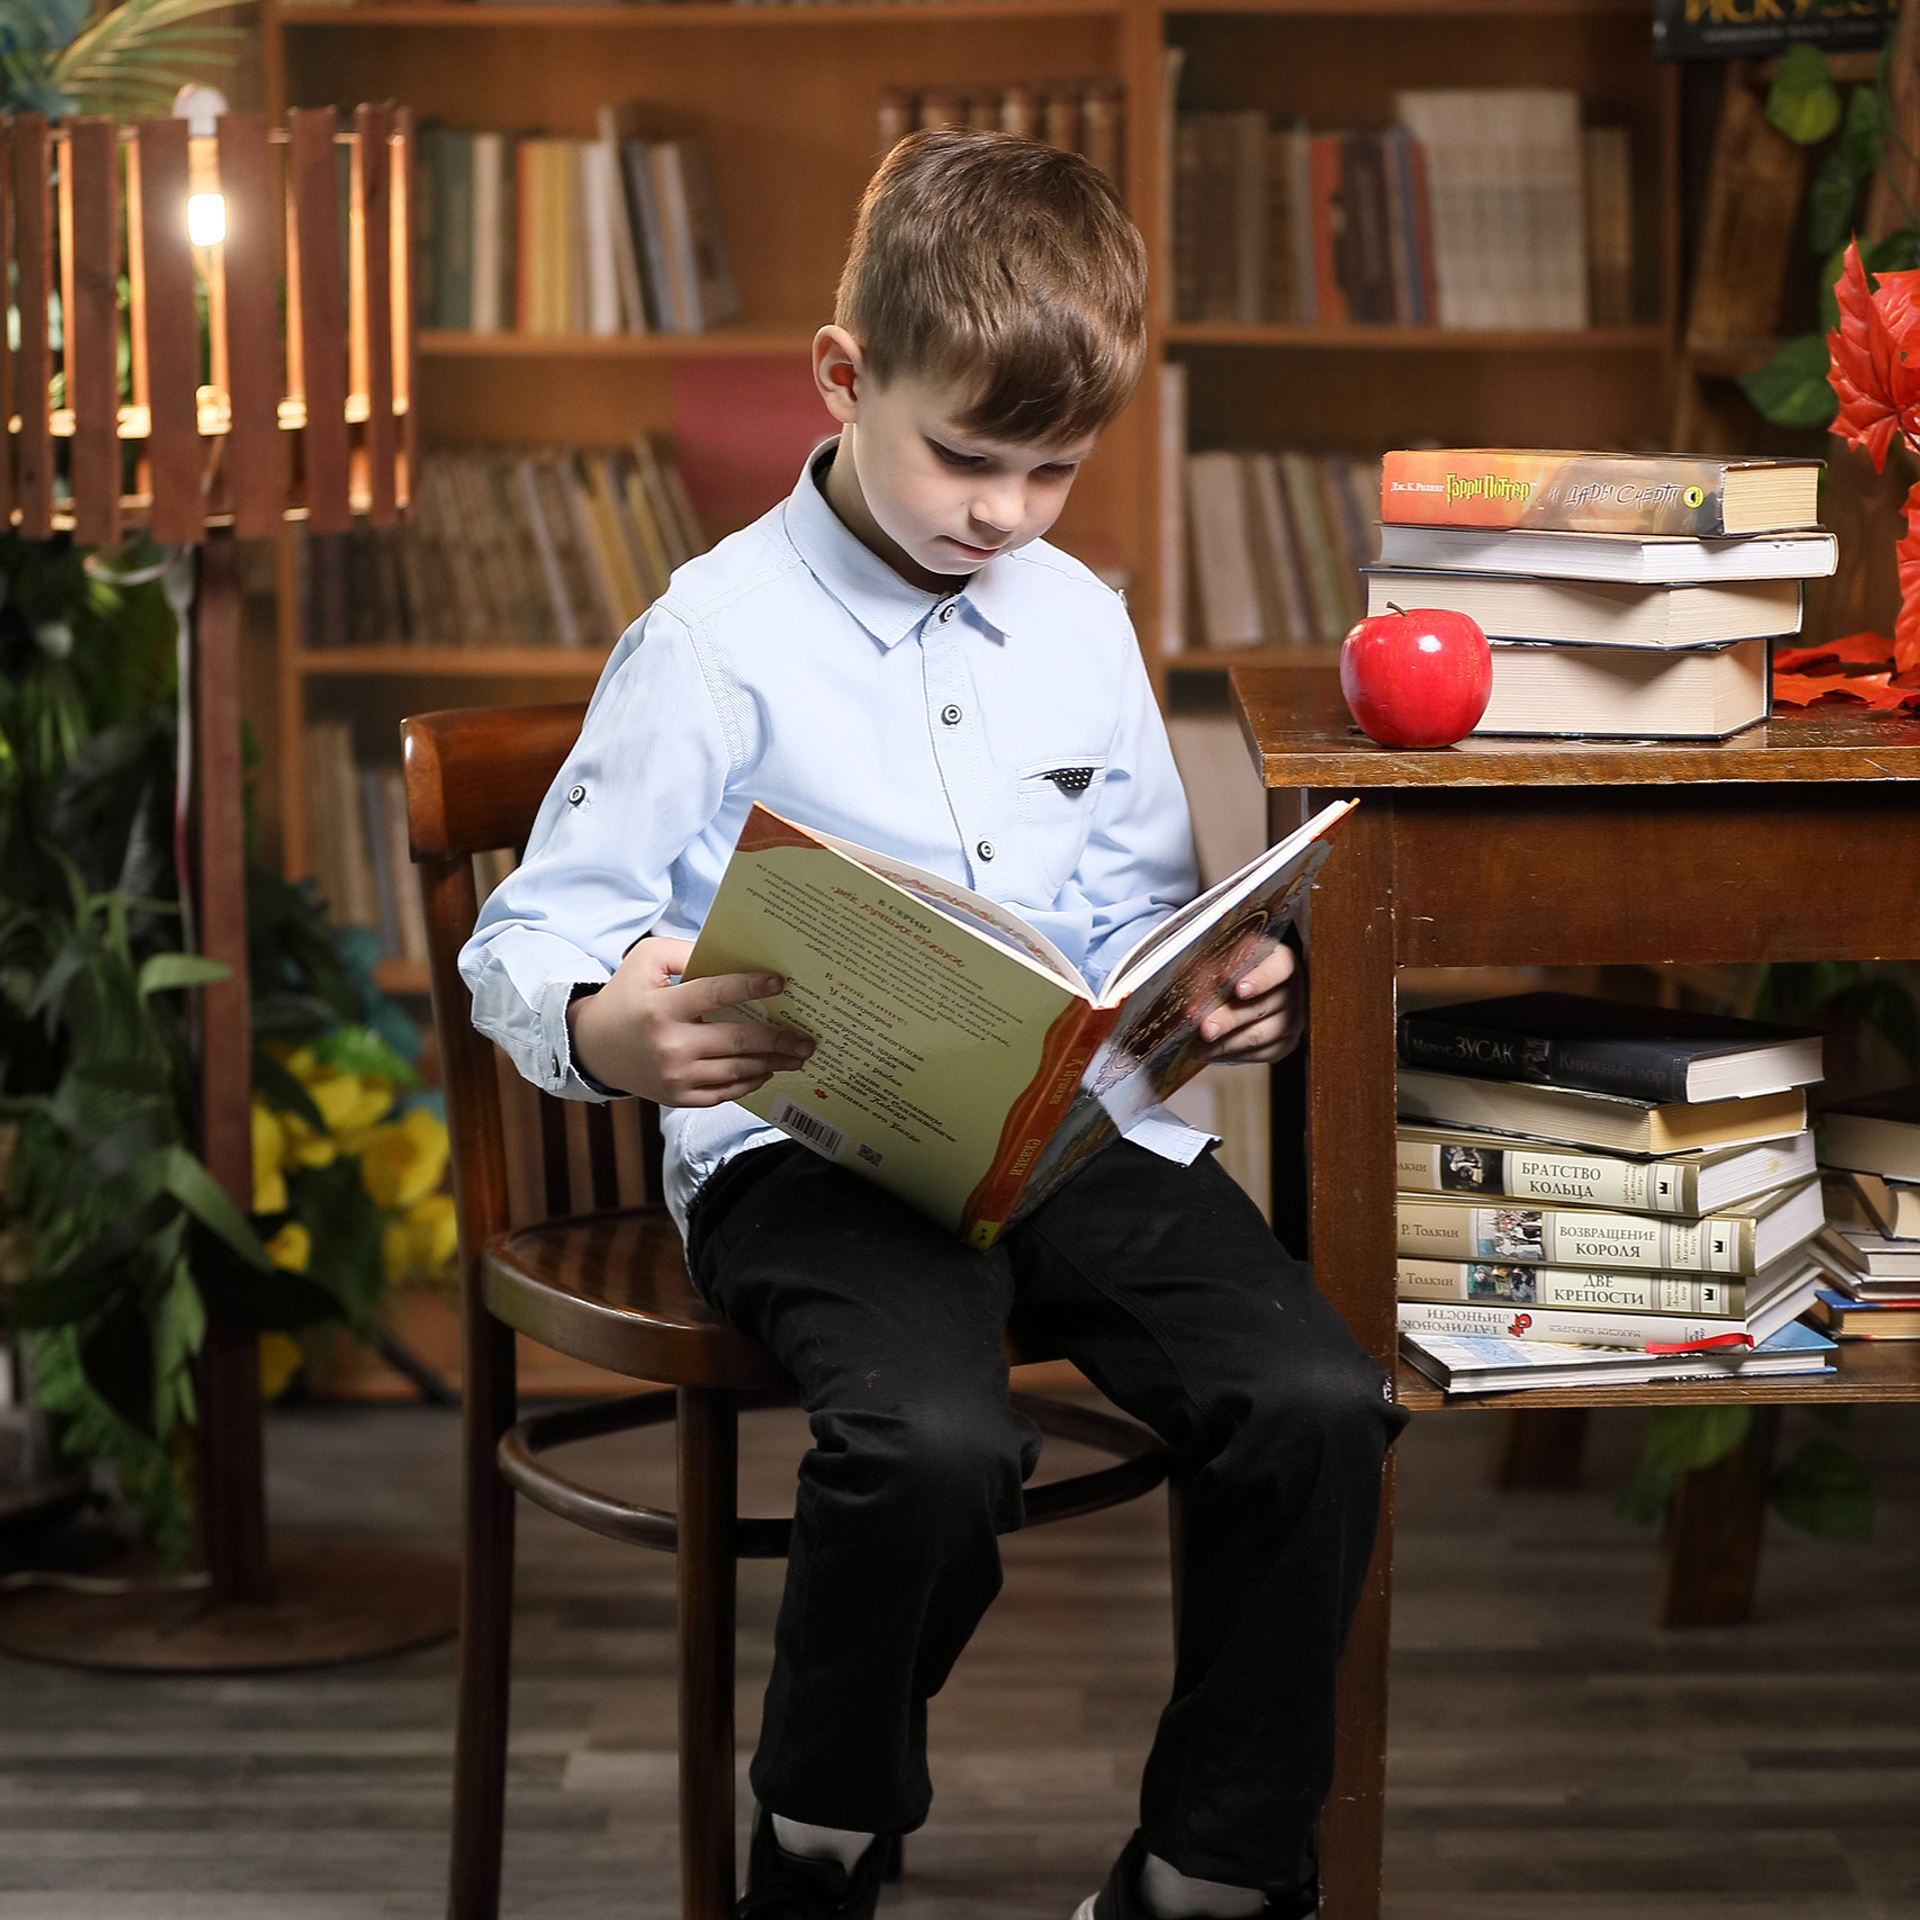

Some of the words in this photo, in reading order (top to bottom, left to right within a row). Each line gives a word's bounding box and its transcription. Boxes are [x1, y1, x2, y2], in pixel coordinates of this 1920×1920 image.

[1446, 473, 1482, 503] Гарри
[1484, 473, 1530, 502] Поттер
[888, 905, 931, 933] СЕРИЮ
[1454, 1036, 1516, 1065] ЗУСАК
[1009, 1138, 1042, 1176] Сказки
[1399, 1162, 1428, 1173] лкин
[1521, 1161, 1602, 1181] БРАТСТВО
[1529, 1180, 1595, 1200] КОЛЬЦА
[1413, 1224, 1459, 1238] Толкин
[1559, 1226, 1657, 1243] ВОЗВРАЩЕНИЕ
[1576, 1242, 1641, 1259] КОРОЛЯ
[1406, 1272, 1454, 1287] Толкин
[1583, 1273, 1615, 1288] ДВЕ
[1554, 1289, 1645, 1305] КРЕПОСТИ
[1427, 1308, 1510, 1324] ЛИЧНОСТИ
[1400, 1319, 1500, 1336] ТАТУИРОВОК
